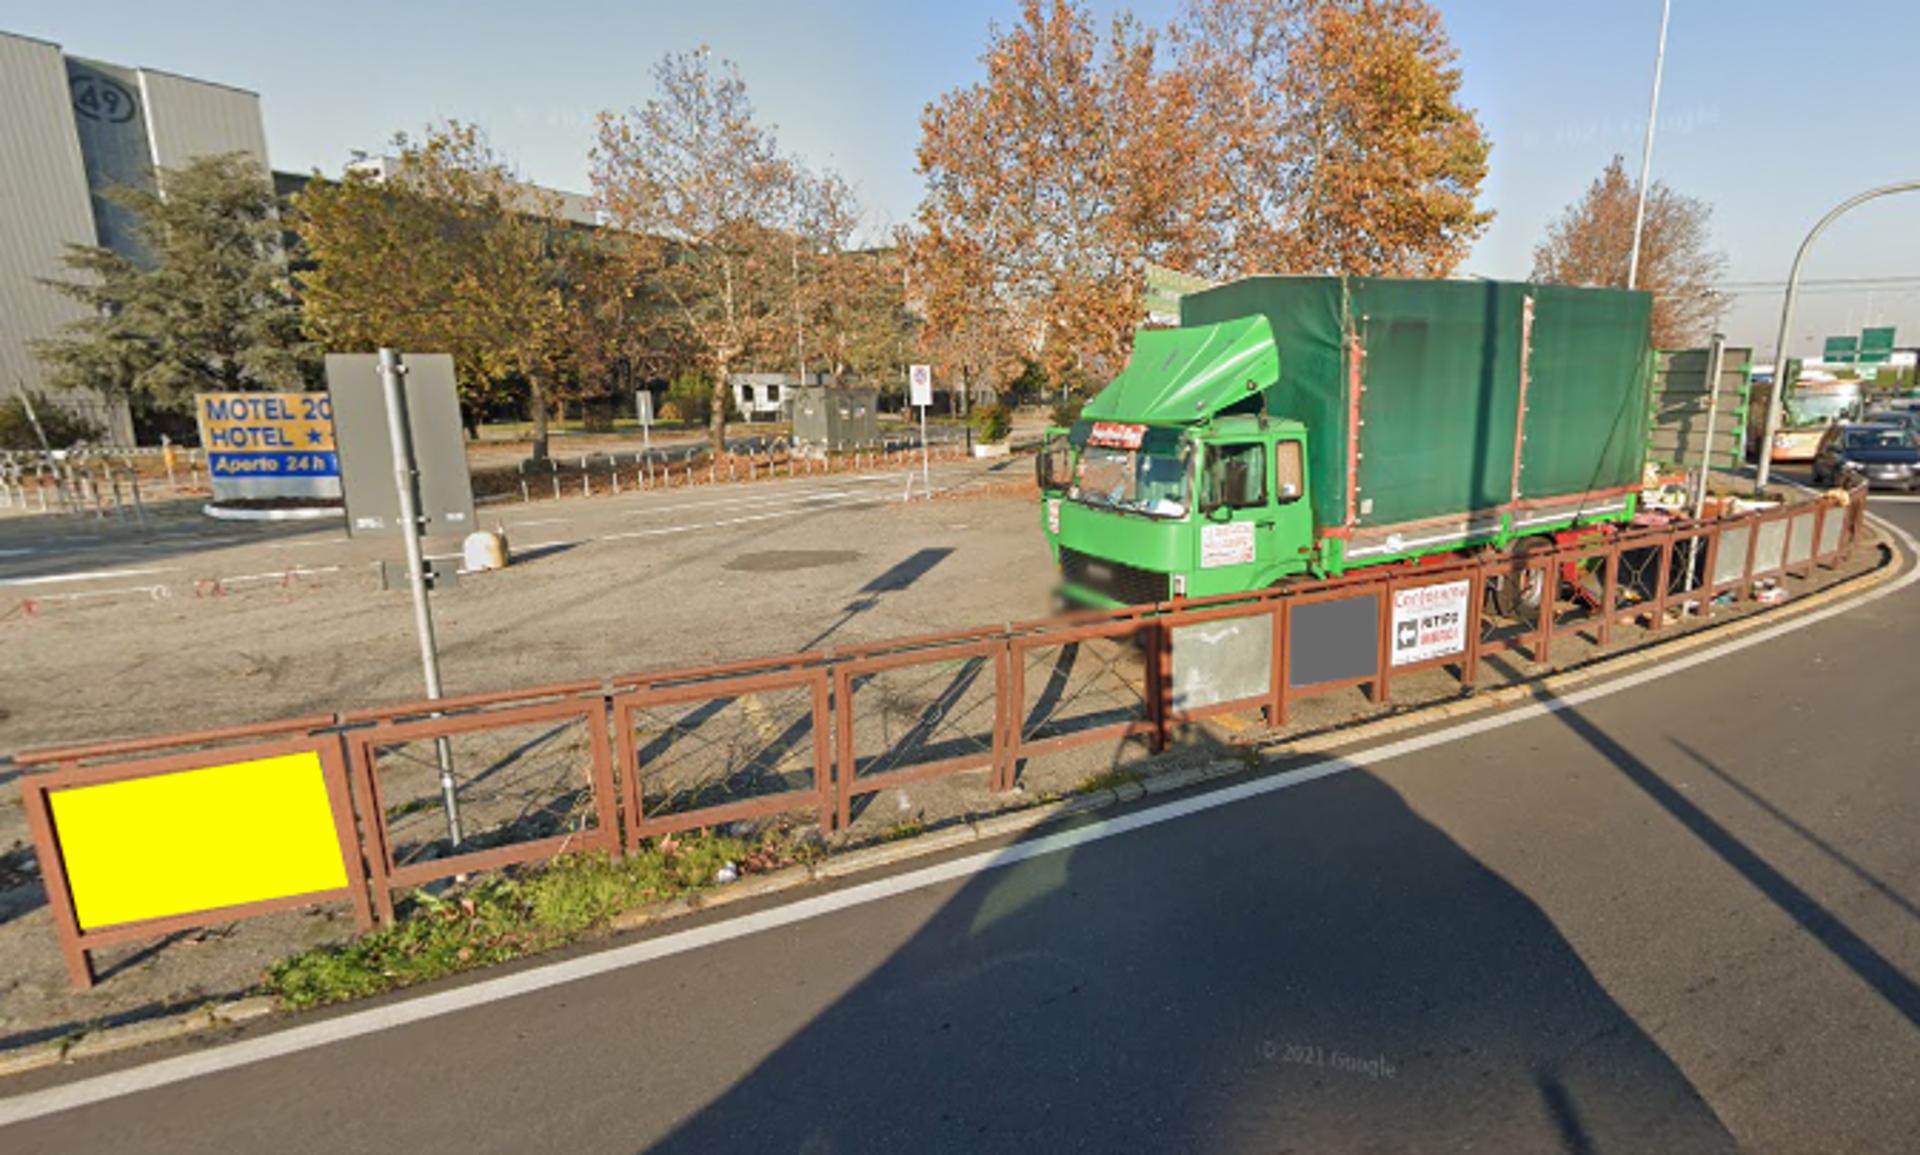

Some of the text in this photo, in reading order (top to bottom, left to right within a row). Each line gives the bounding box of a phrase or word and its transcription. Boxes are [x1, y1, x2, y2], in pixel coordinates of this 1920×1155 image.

[80, 85, 120, 114] 49
[205, 398, 296, 420] MOTEL
[210, 426, 294, 447] HOTEL
[216, 456, 279, 474] Aperto
